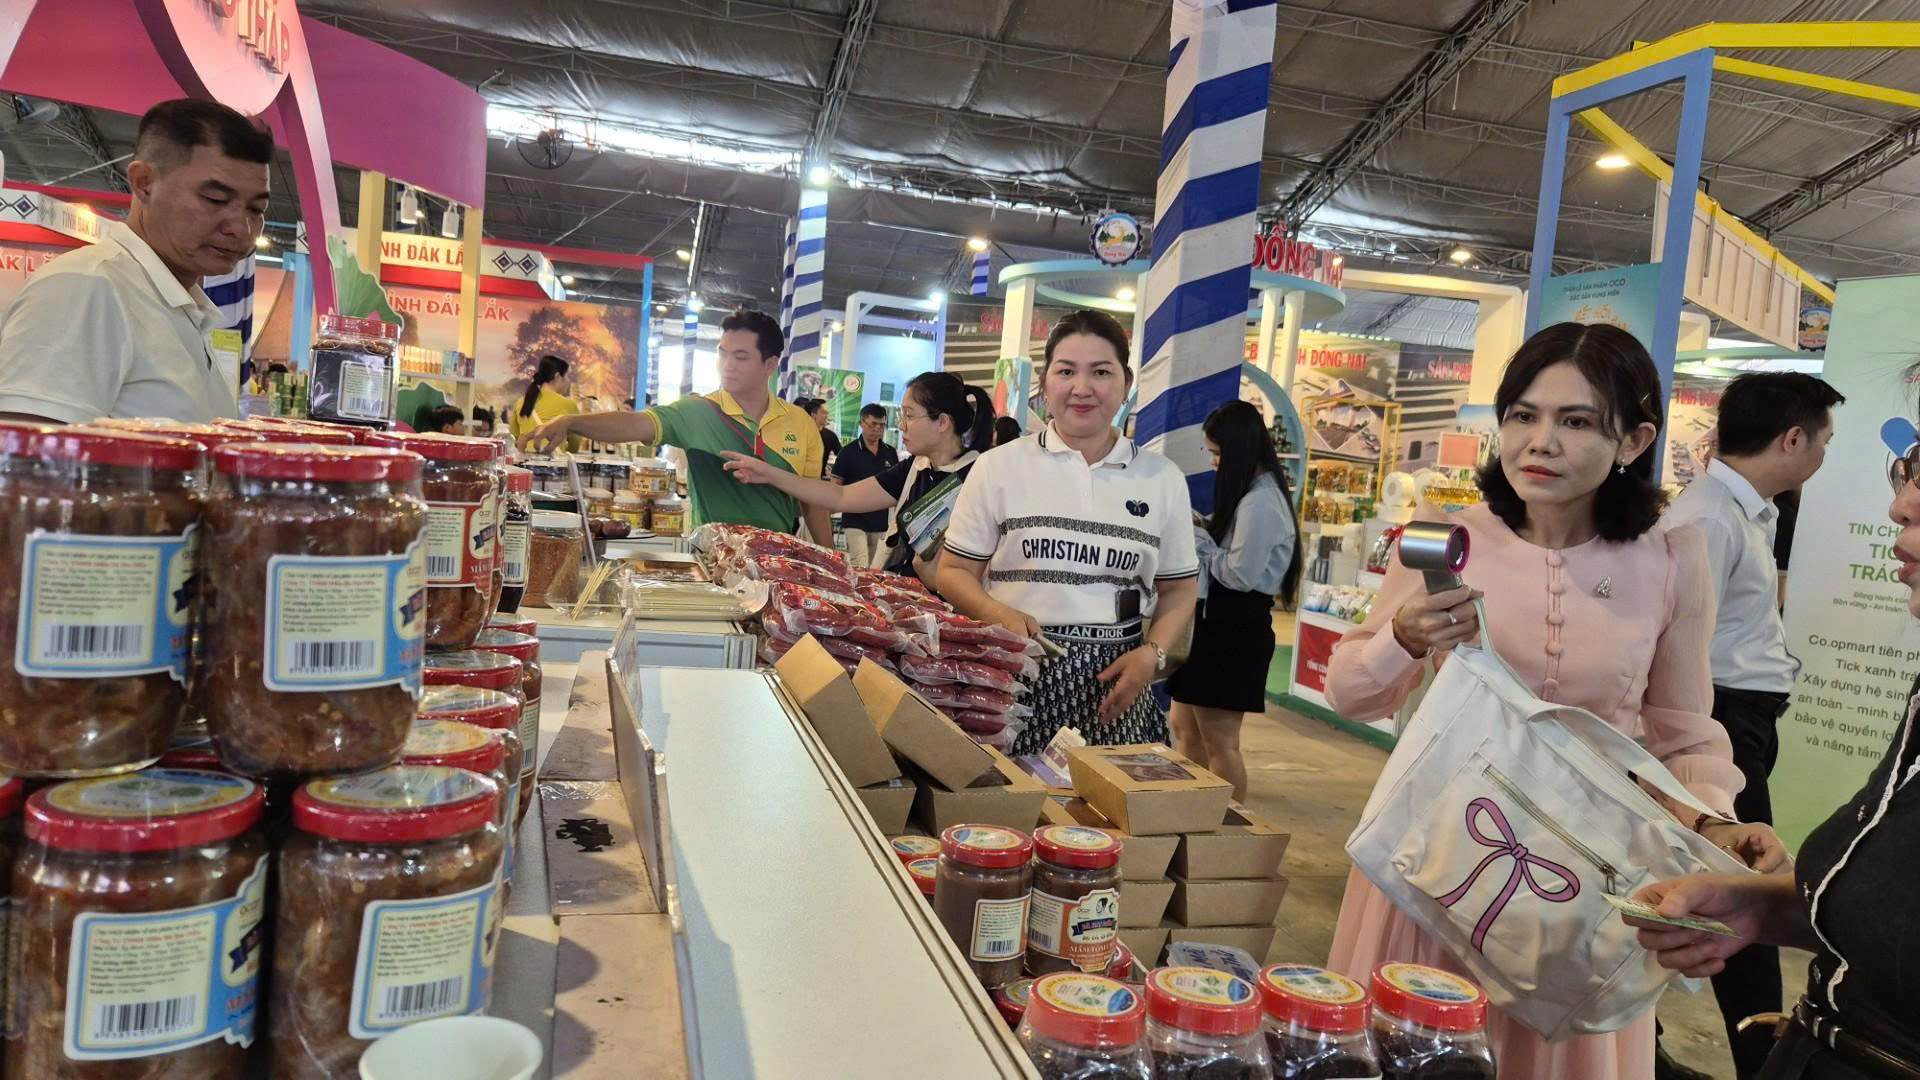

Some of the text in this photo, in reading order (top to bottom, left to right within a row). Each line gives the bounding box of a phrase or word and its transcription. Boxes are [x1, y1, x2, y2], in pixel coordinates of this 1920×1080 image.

[381, 241, 401, 258] NH
[446, 244, 463, 265] LẮ
[1848, 522, 1900, 538] TIN CH
[1022, 538, 1140, 572] CHRISTIAN DIOR
[1849, 563, 1901, 584] TRÁC
[1096, 628, 1124, 639] DIOR
[1808, 634, 1875, 655] Co.opmart
[1836, 658, 1918, 682] Tick xanh trá
[1803, 673, 1911, 702] Xây dựng hệ sin
[1794, 711, 1818, 725] bảo
[1797, 694, 1813, 704] an
[1817, 696, 1843, 710] toàn
[1857, 704, 1889, 719] minh
[1893, 710, 1902, 722] b
[1805, 735, 1820, 746] và
